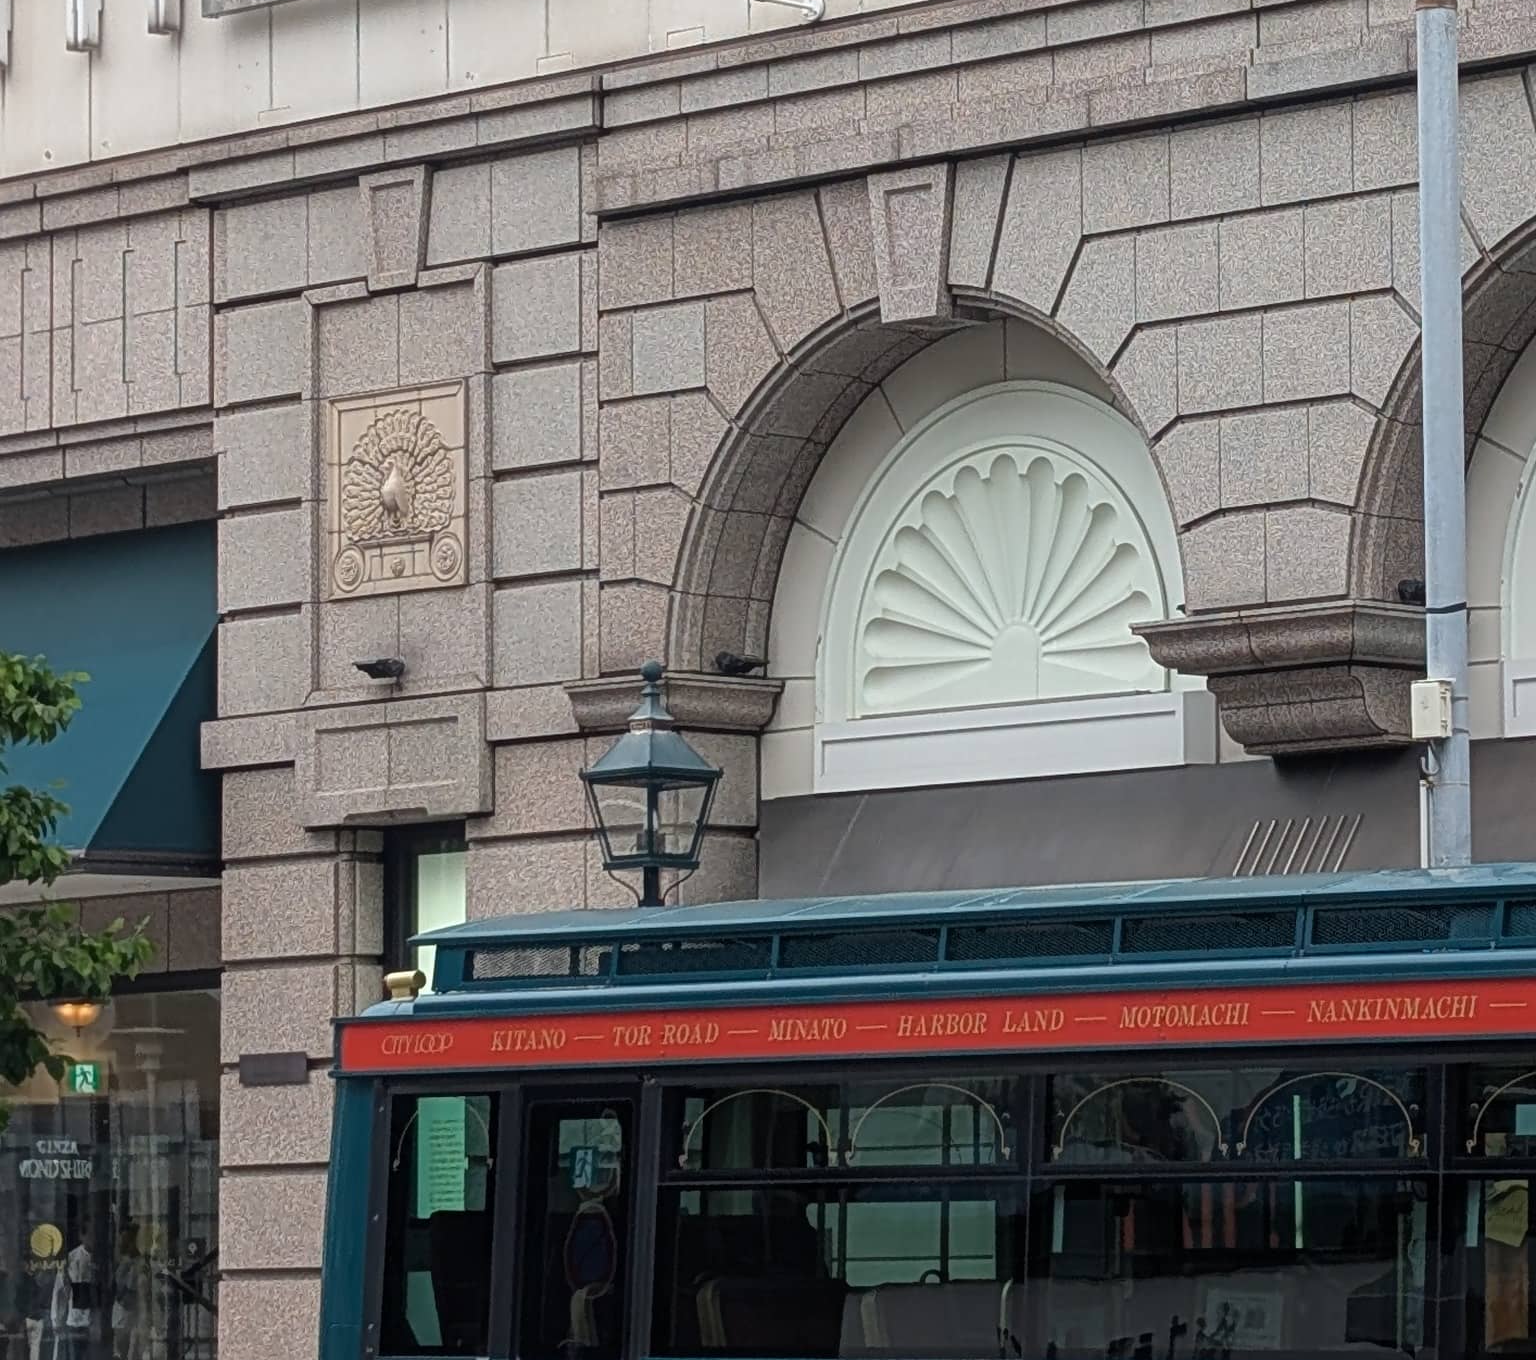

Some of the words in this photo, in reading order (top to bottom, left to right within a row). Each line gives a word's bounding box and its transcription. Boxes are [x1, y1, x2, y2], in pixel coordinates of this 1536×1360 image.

[491, 1029, 566, 1052] KITANO
[612, 1025, 651, 1047] TOR
[660, 1023, 720, 1046] ROAD
[768, 1018, 848, 1041] MINATO
[897, 1012, 988, 1037] HARBOR
[1002, 1009, 1065, 1033] LAND
[1119, 1002, 1251, 1028] MOTOMACHI
[1306, 995, 1478, 1023] NANKINMACHI
[381, 1034, 414, 1055] CITY
[414, 1033, 454, 1054] LOOP
